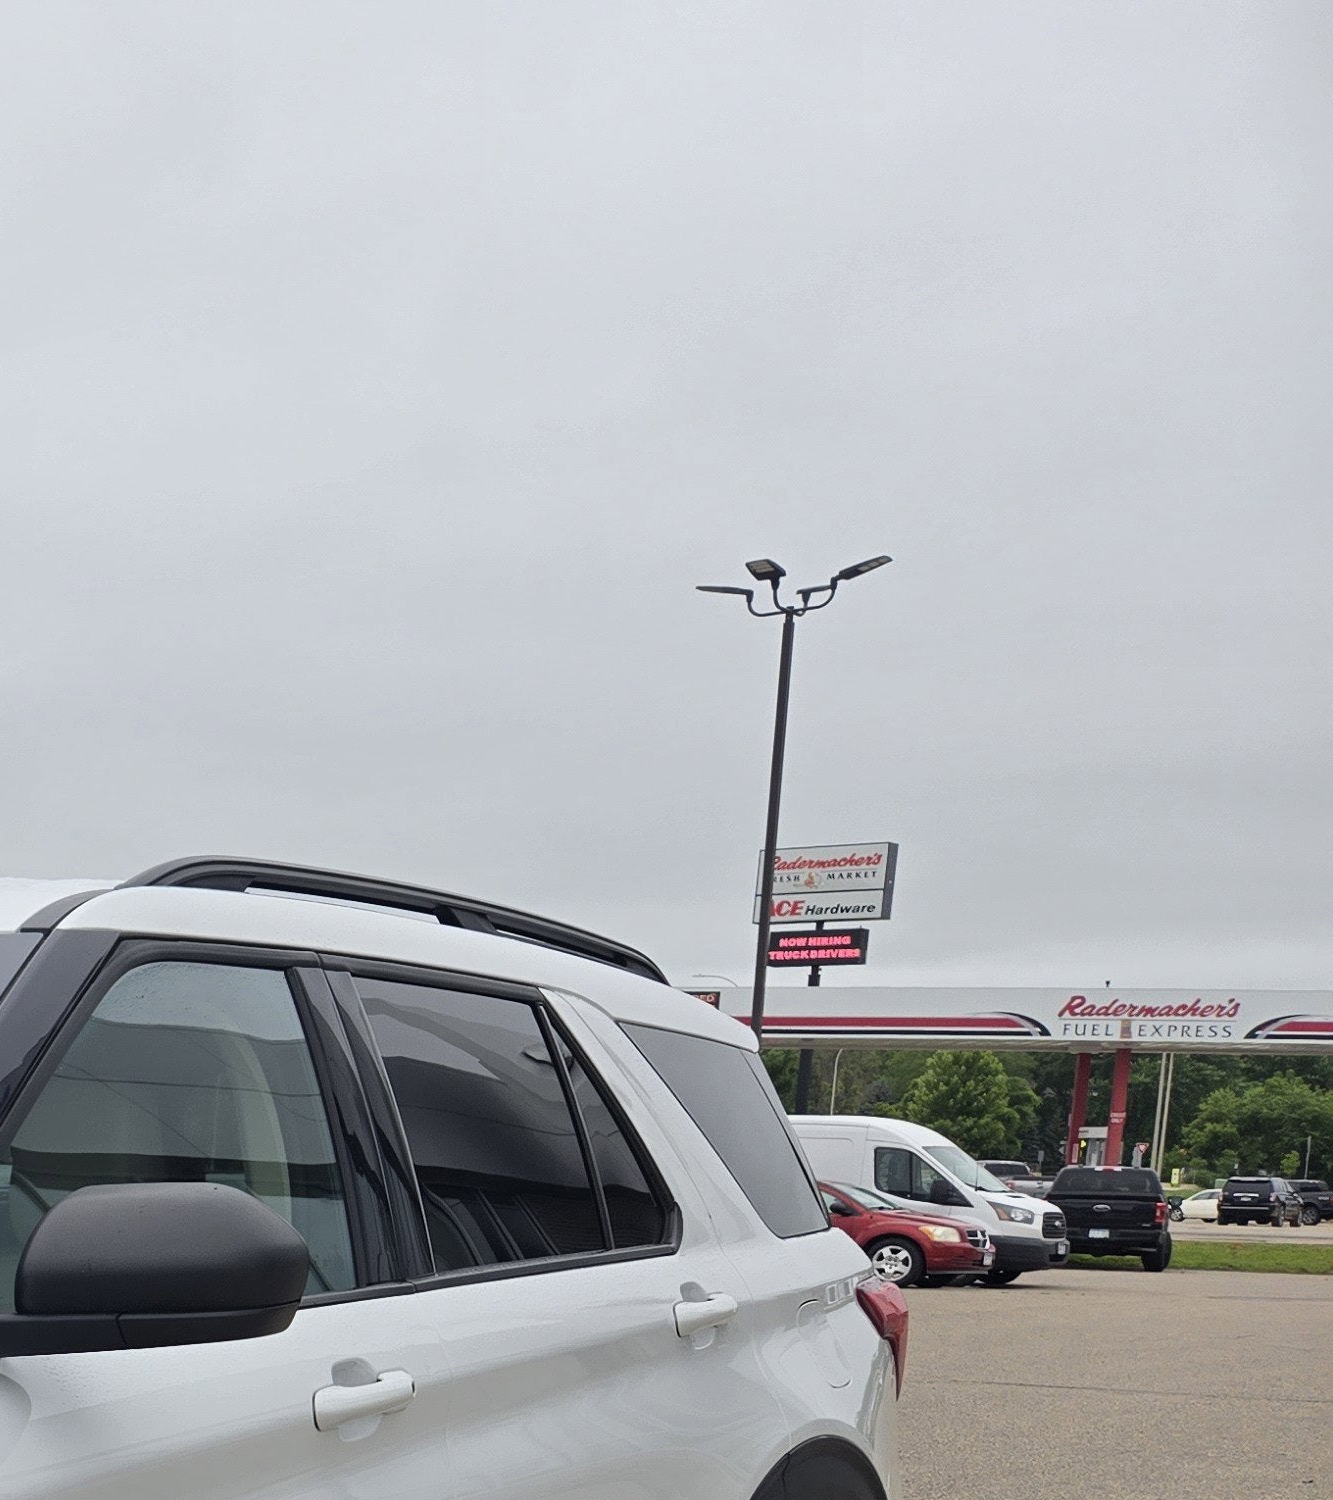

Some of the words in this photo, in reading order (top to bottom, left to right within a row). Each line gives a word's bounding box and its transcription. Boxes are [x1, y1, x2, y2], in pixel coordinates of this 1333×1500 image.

[773, 875, 800, 883] RESH
[826, 871, 877, 880] MARKET
[804, 903, 876, 916] Hardware
[779, 937, 807, 947] NOW
[808, 936, 851, 946] HIRING
[768, 949, 809, 960] TRUCK
[810, 948, 861, 959] DRIVERS
[1058, 995, 1241, 1018] Radermacher's
[1063, 1023, 1114, 1036] FUEL
[1138, 1024, 1232, 1038] EXPRESS
